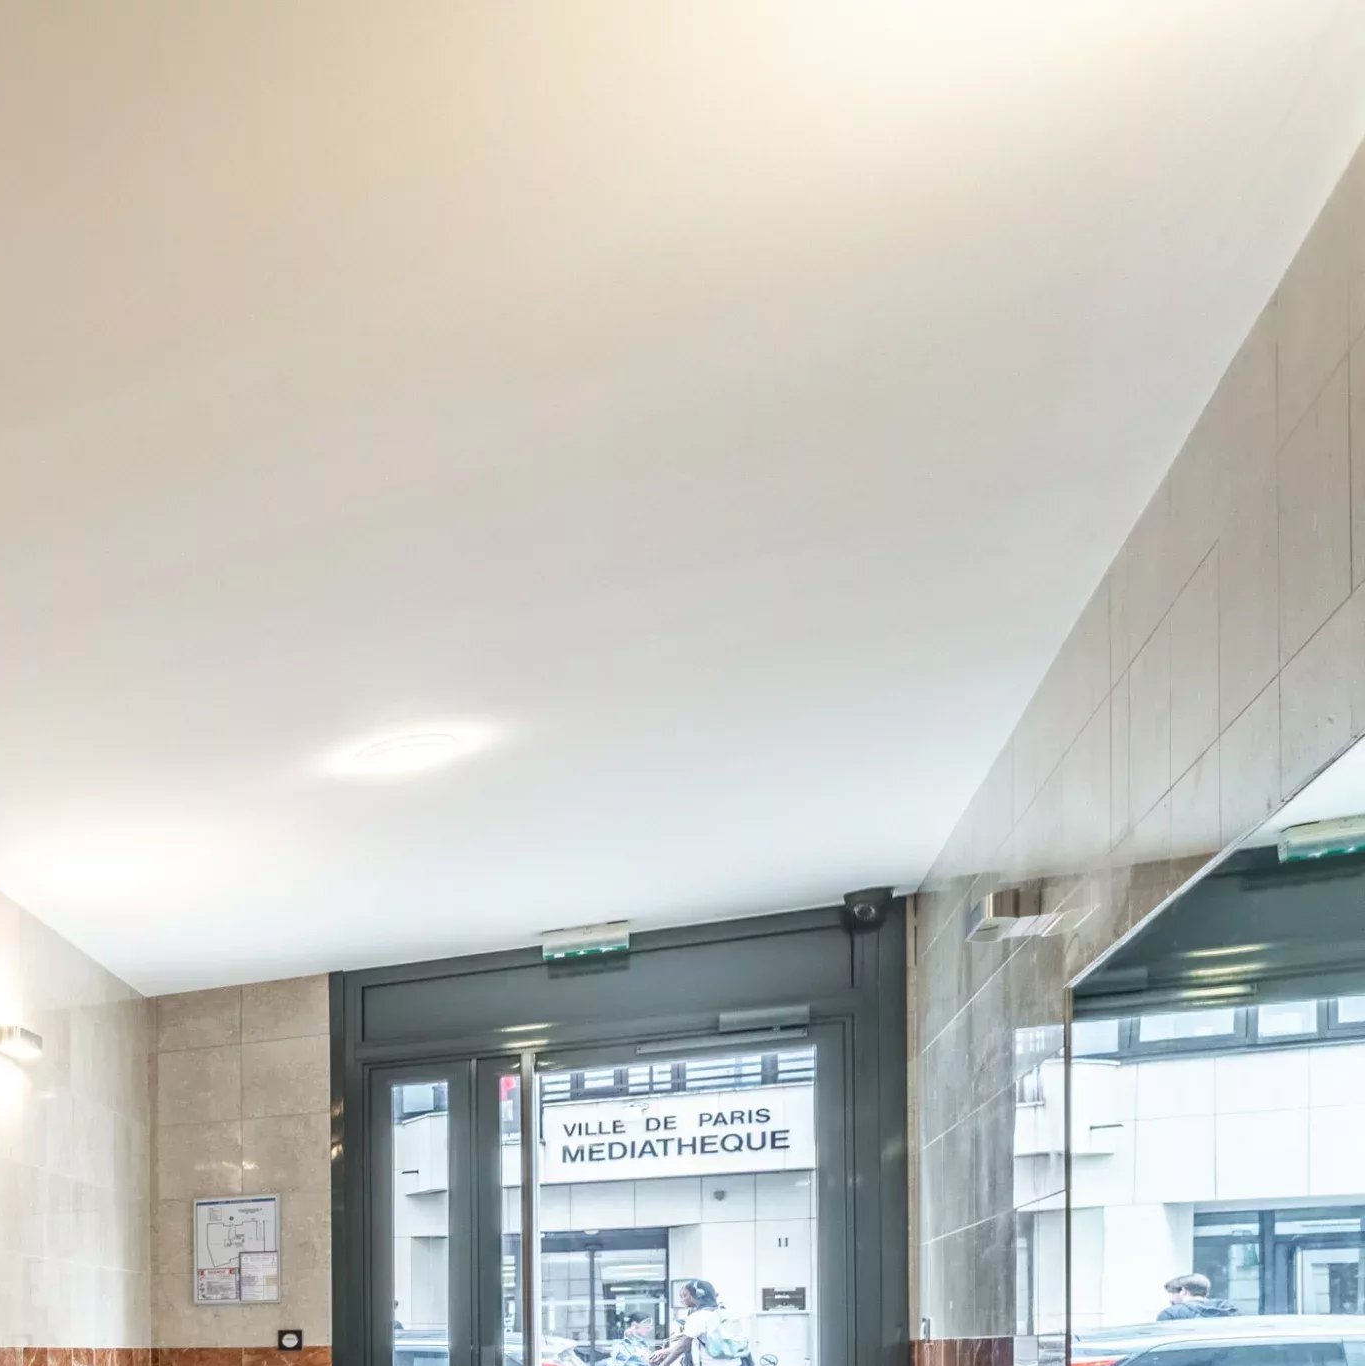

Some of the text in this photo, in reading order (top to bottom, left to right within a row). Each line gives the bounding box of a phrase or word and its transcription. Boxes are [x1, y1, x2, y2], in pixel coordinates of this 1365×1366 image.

[563, 1108, 772, 1137] VILLE DE PARIS
[561, 1129, 791, 1164] MEDIATHEQUE
